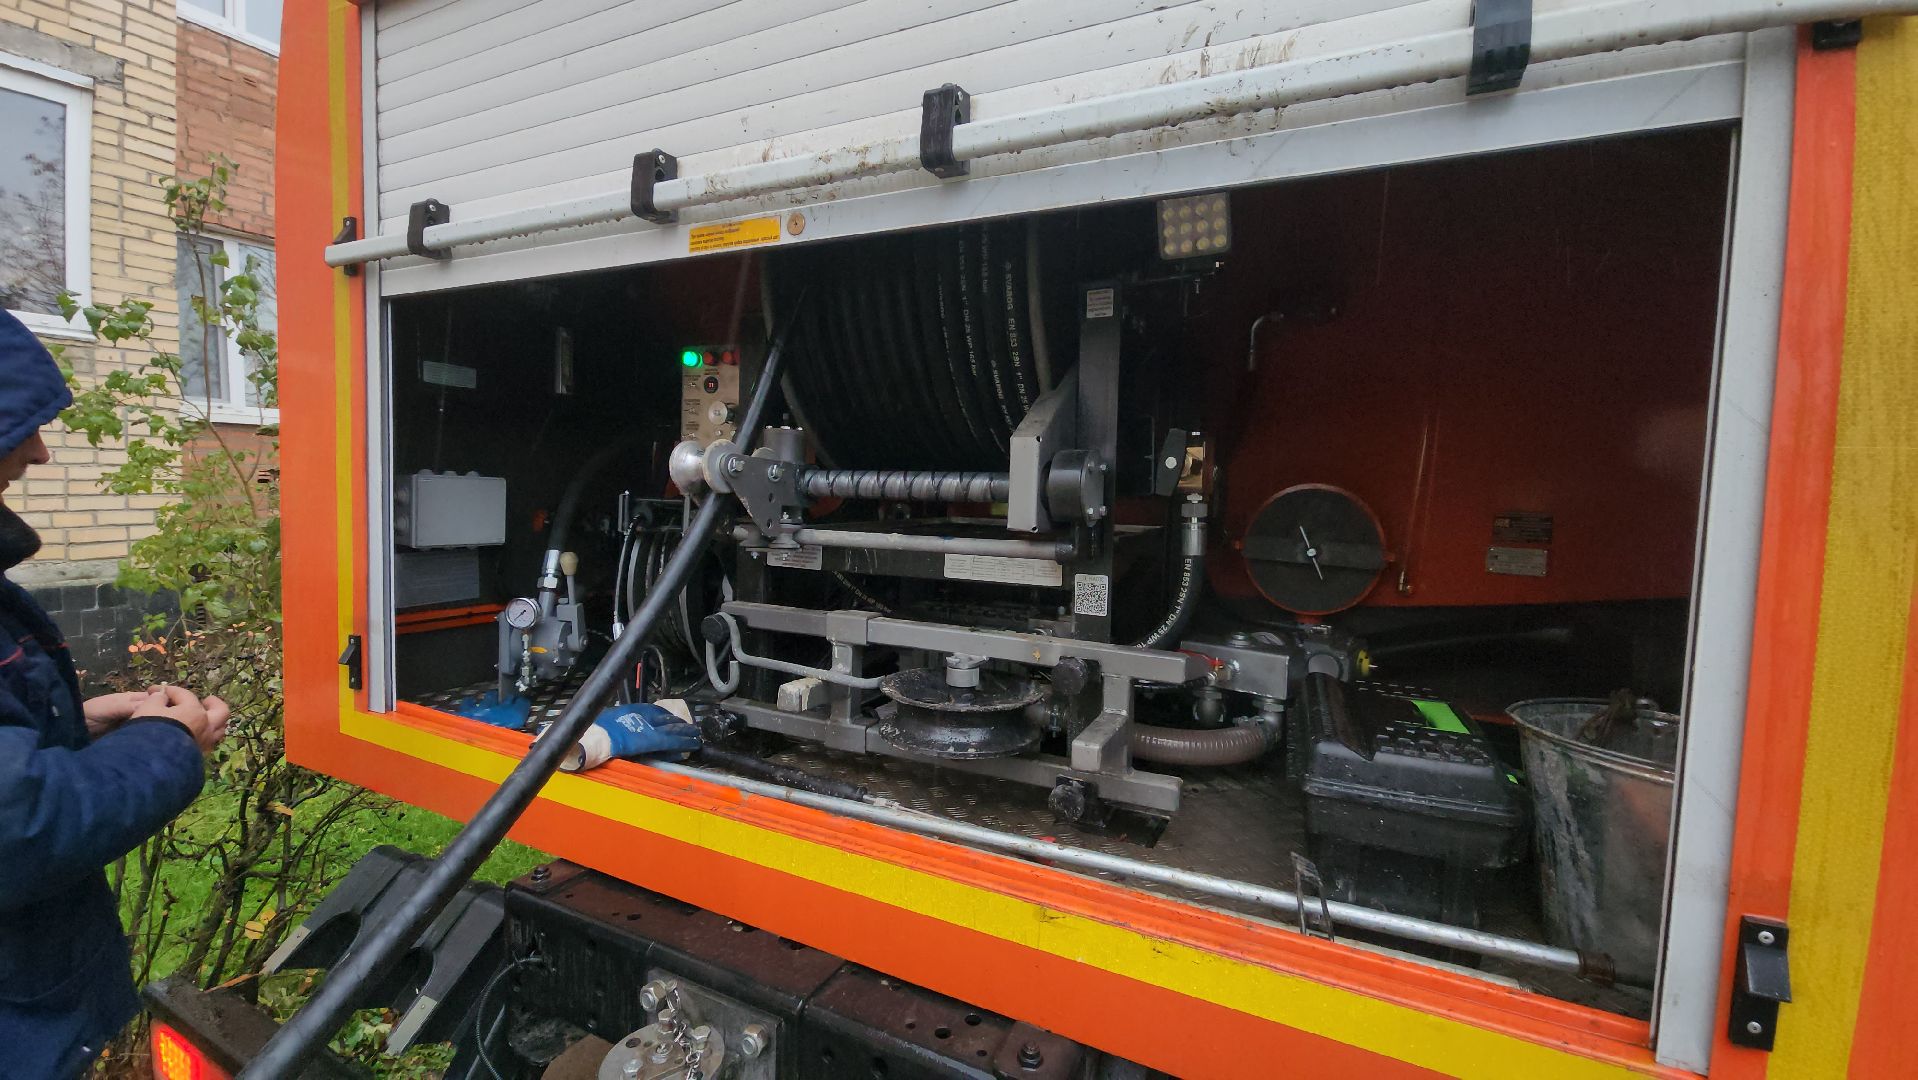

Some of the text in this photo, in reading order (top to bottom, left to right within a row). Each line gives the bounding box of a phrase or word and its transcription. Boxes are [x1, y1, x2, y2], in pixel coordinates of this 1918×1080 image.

[1006, 273, 1014, 311] SVAROG
[963, 309, 970, 322] DN
[1009, 318, 1016, 333] EN
[1010, 332, 1018, 348] 853
[1012, 351, 1021, 368] 2SN
[1017, 383, 1026, 395] DN
[1184, 558, 1192, 571] EN
[1176, 587, 1187, 604] 2SN
[1165, 613, 1177, 626] DN
[1158, 624, 1168, 635] 25
[1146, 632, 1160, 645] WP
